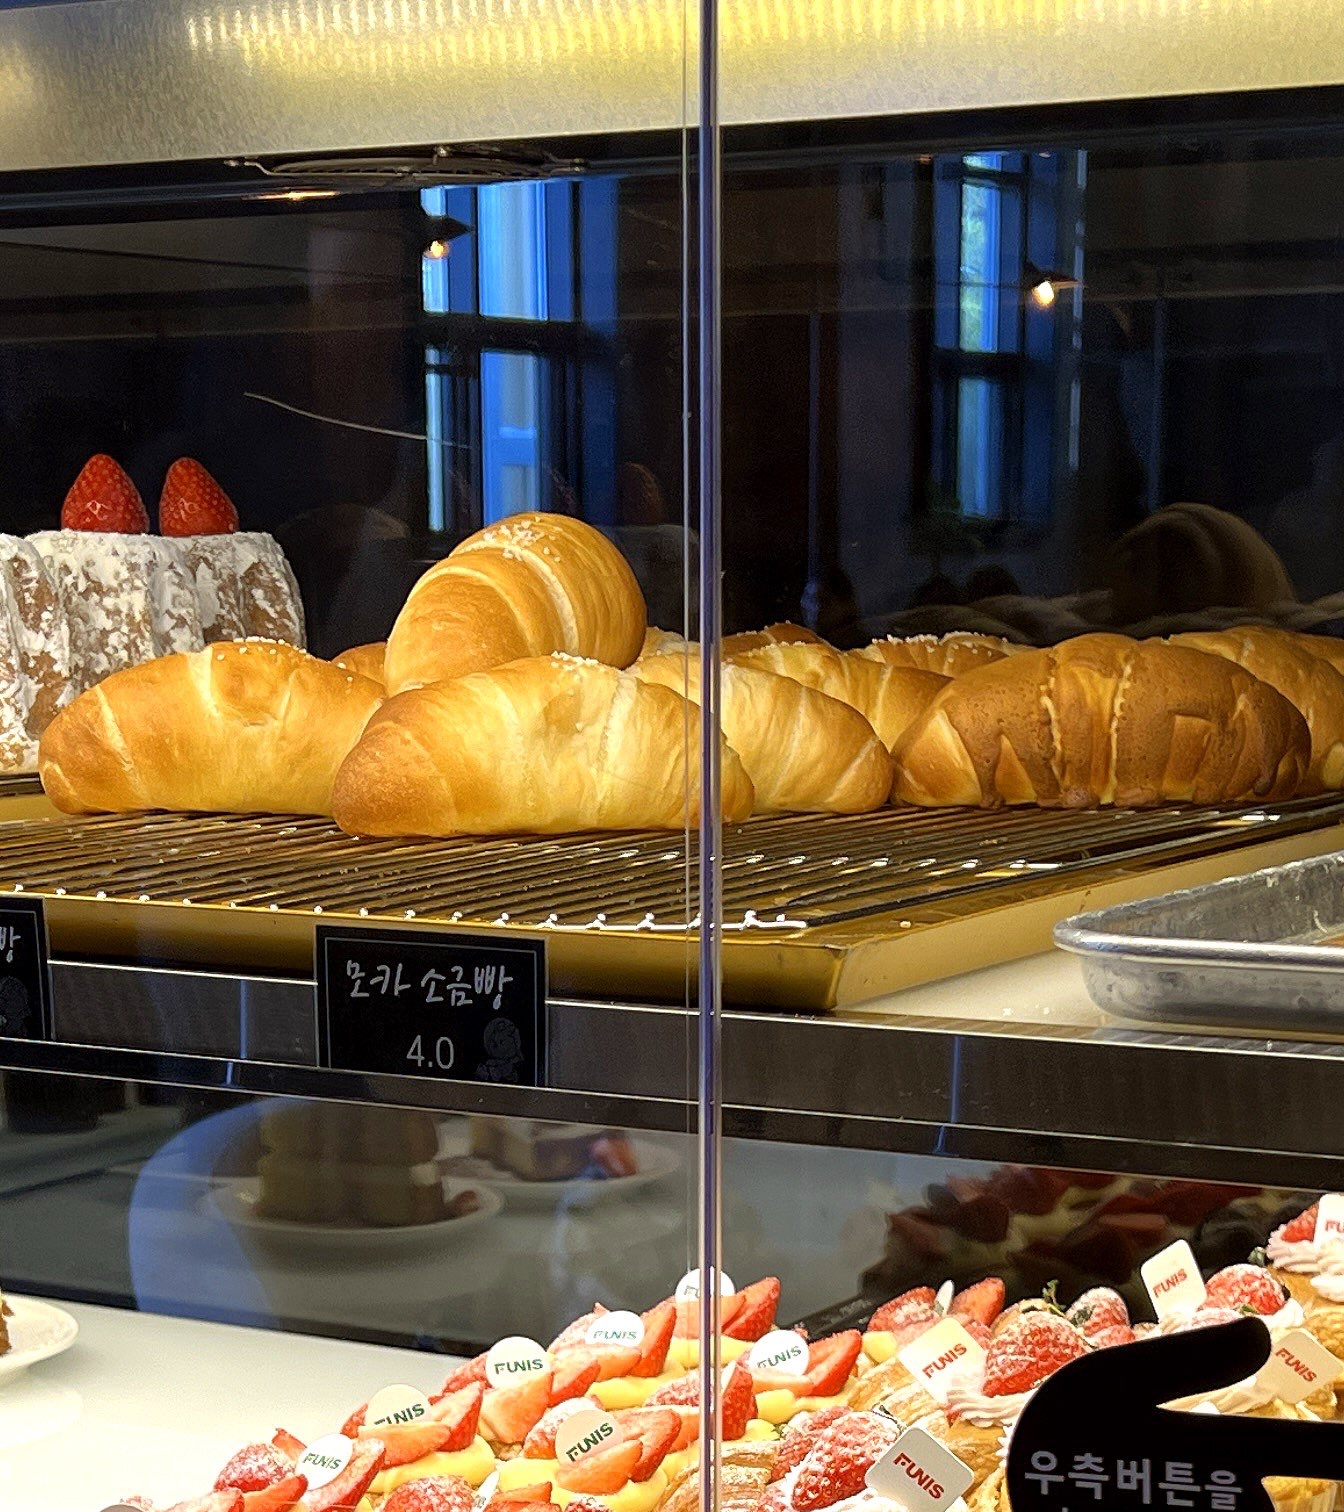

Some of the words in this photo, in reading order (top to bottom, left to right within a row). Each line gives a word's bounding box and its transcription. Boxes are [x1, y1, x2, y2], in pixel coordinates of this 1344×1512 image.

[346, 959, 412, 997] 모카
[420, 964, 514, 1010] 소금빵
[406, 1034, 455, 1070] 4.0
[1152, 1267, 1188, 1299] FUNIS
[593, 1329, 638, 1341] FUNIS
[493, 1358, 544, 1376] FUNIS
[757, 1345, 802, 1370] FUNIS
[922, 1343, 968, 1379] FUNIS
[1275, 1347, 1318, 1383] FUNIS
[565, 1421, 615, 1463] FUNIS
[302, 1452, 342, 1470] FUNIS
[892, 1452, 945, 1500] FUNIS
[1024, 1449, 1244, 1511] 우측버튼을
